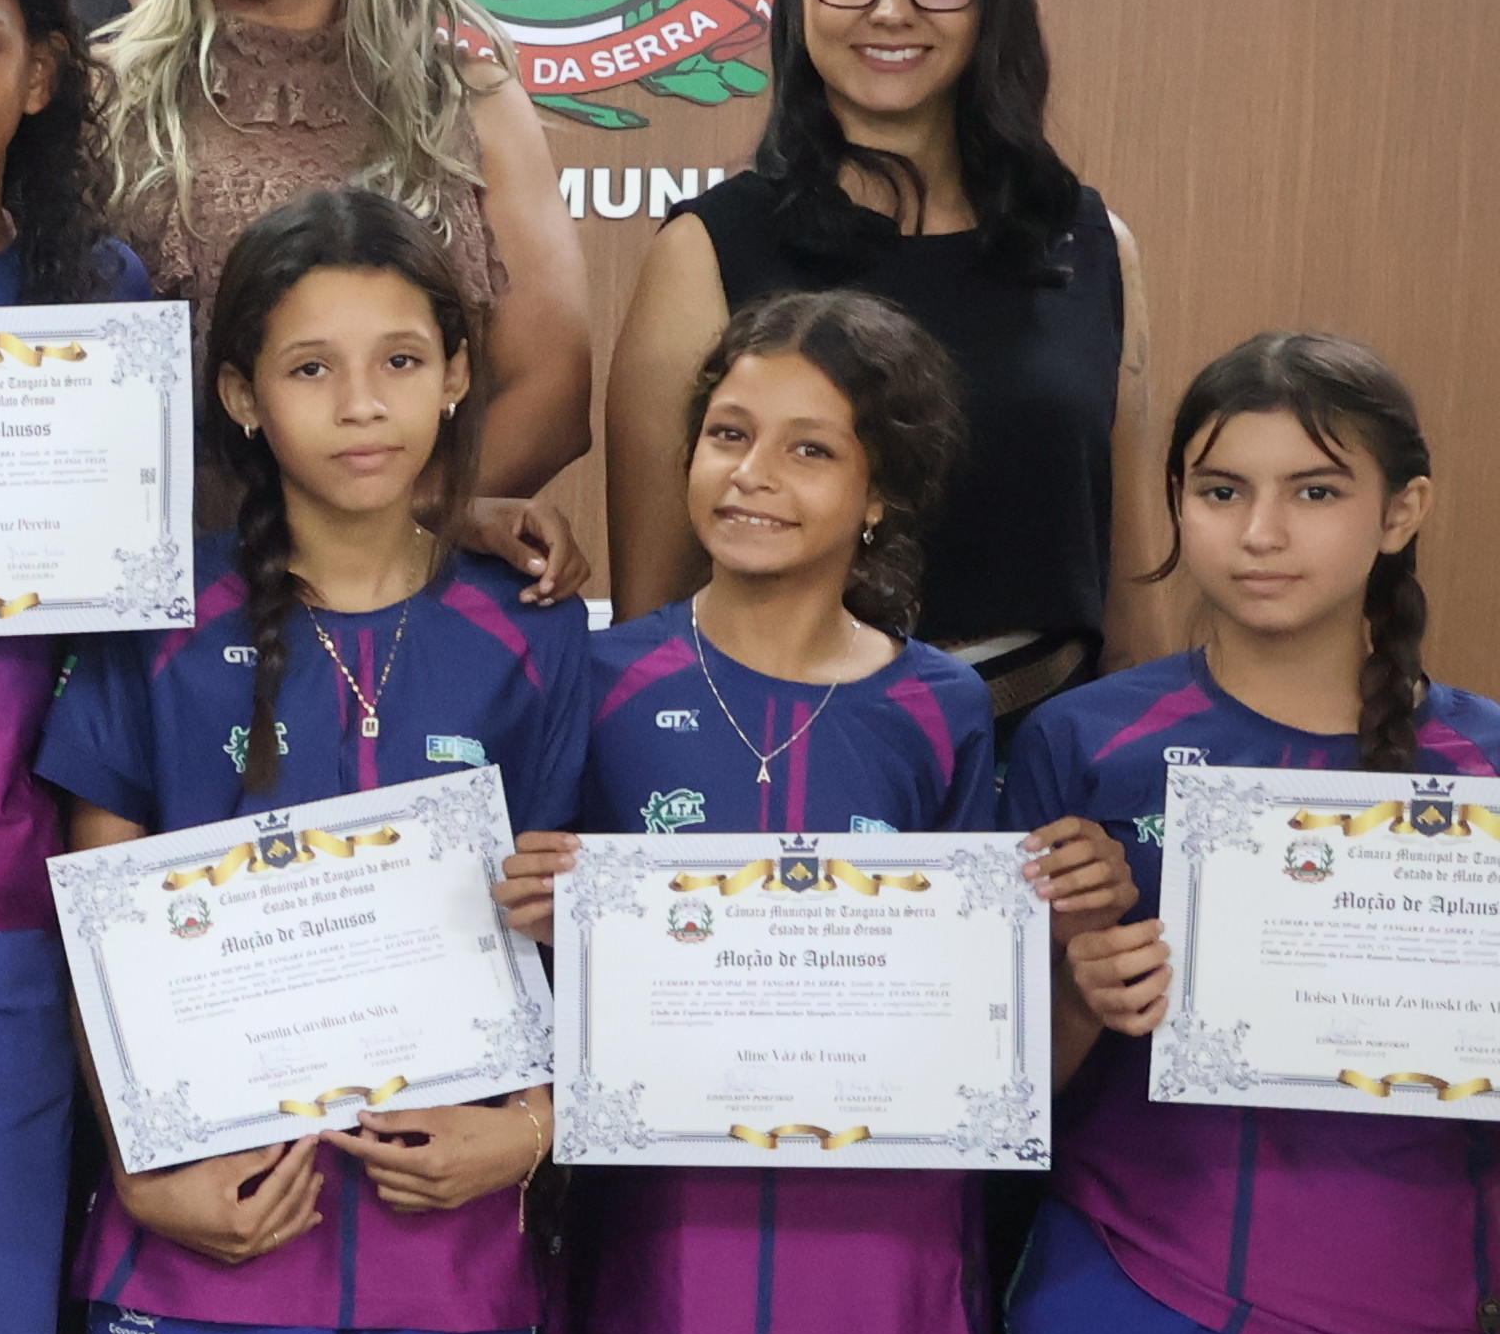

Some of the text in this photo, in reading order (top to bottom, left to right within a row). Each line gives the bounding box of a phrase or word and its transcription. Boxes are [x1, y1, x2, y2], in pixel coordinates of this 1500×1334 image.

[533, 10, 719, 85] DA SERRA
[655, 709, 700, 730] GTX
[1331, 890, 1500, 918] Moção de Aplaus
[220, 908, 377, 958] Moção de Aplausos
[714, 949, 887, 972] Moção de Aplausos
